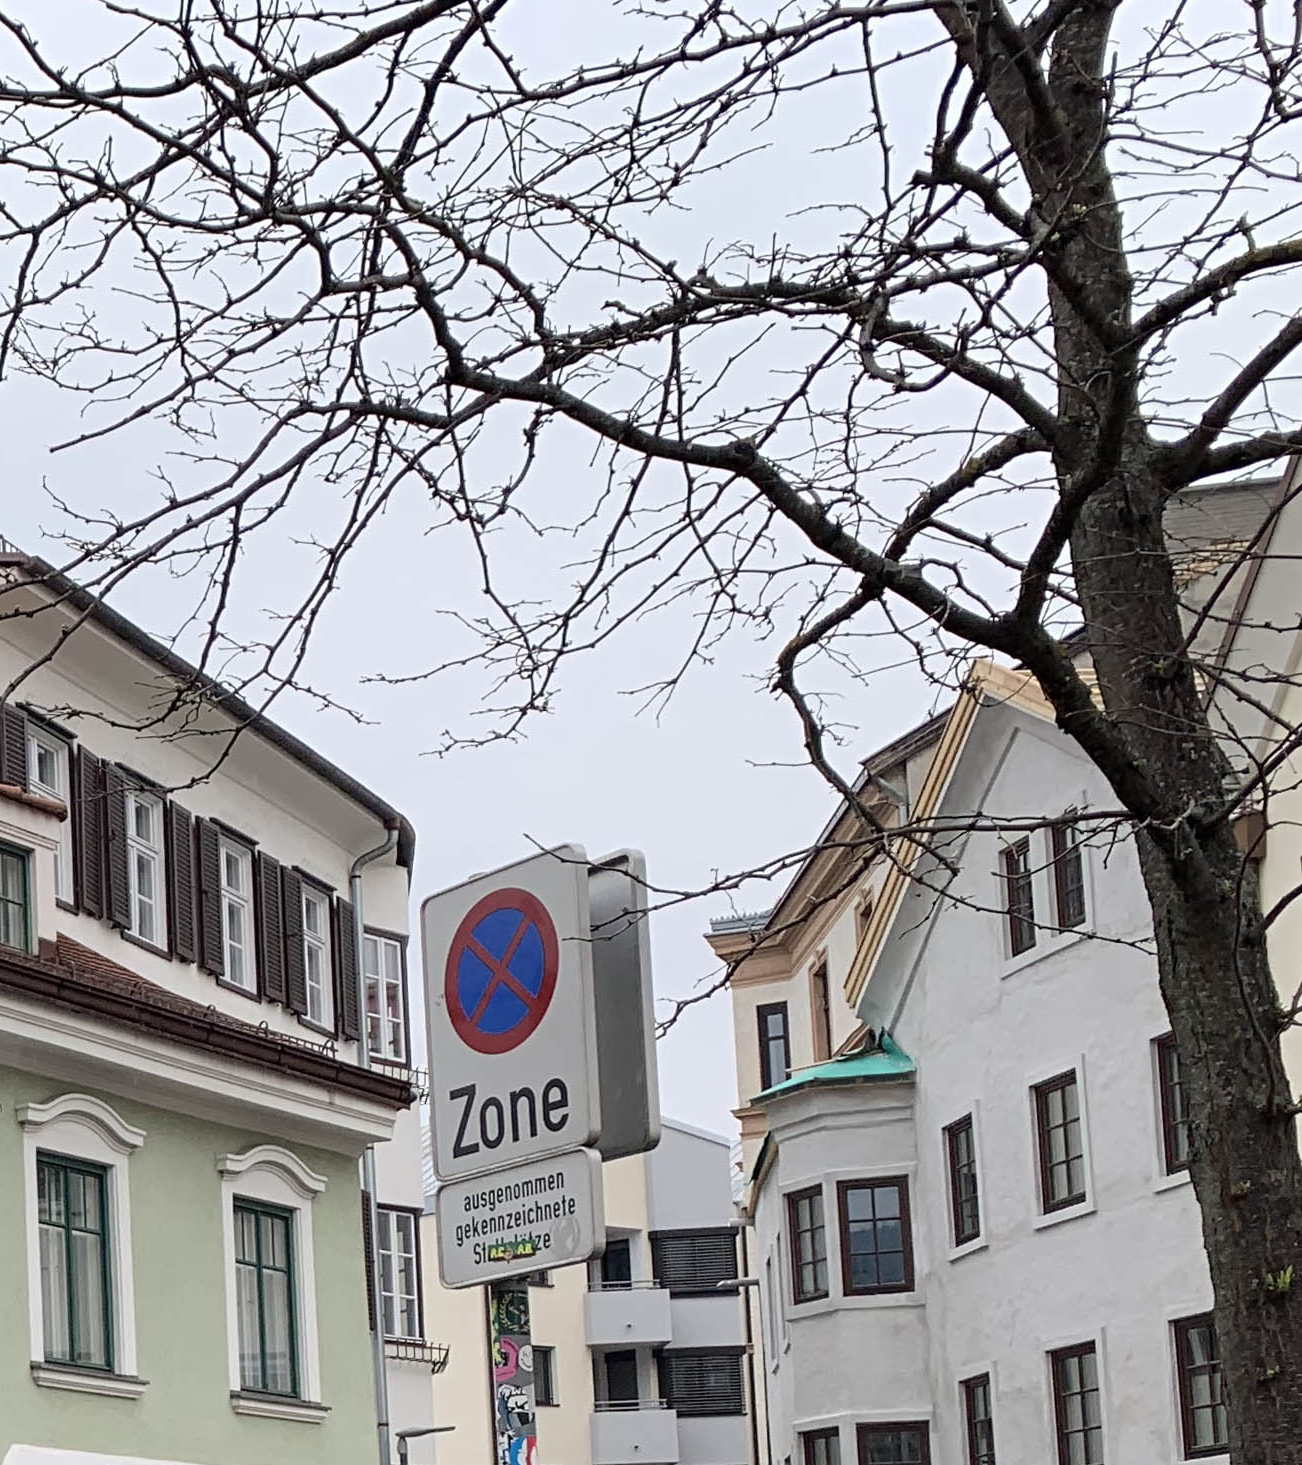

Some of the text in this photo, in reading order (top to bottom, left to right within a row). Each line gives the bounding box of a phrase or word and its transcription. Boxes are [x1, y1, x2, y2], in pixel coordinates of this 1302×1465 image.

[449, 1077, 570, 1159] Zone
[463, 1171, 565, 1213] ausgenommen
[455, 1196, 577, 1248] gekennzeichnete
